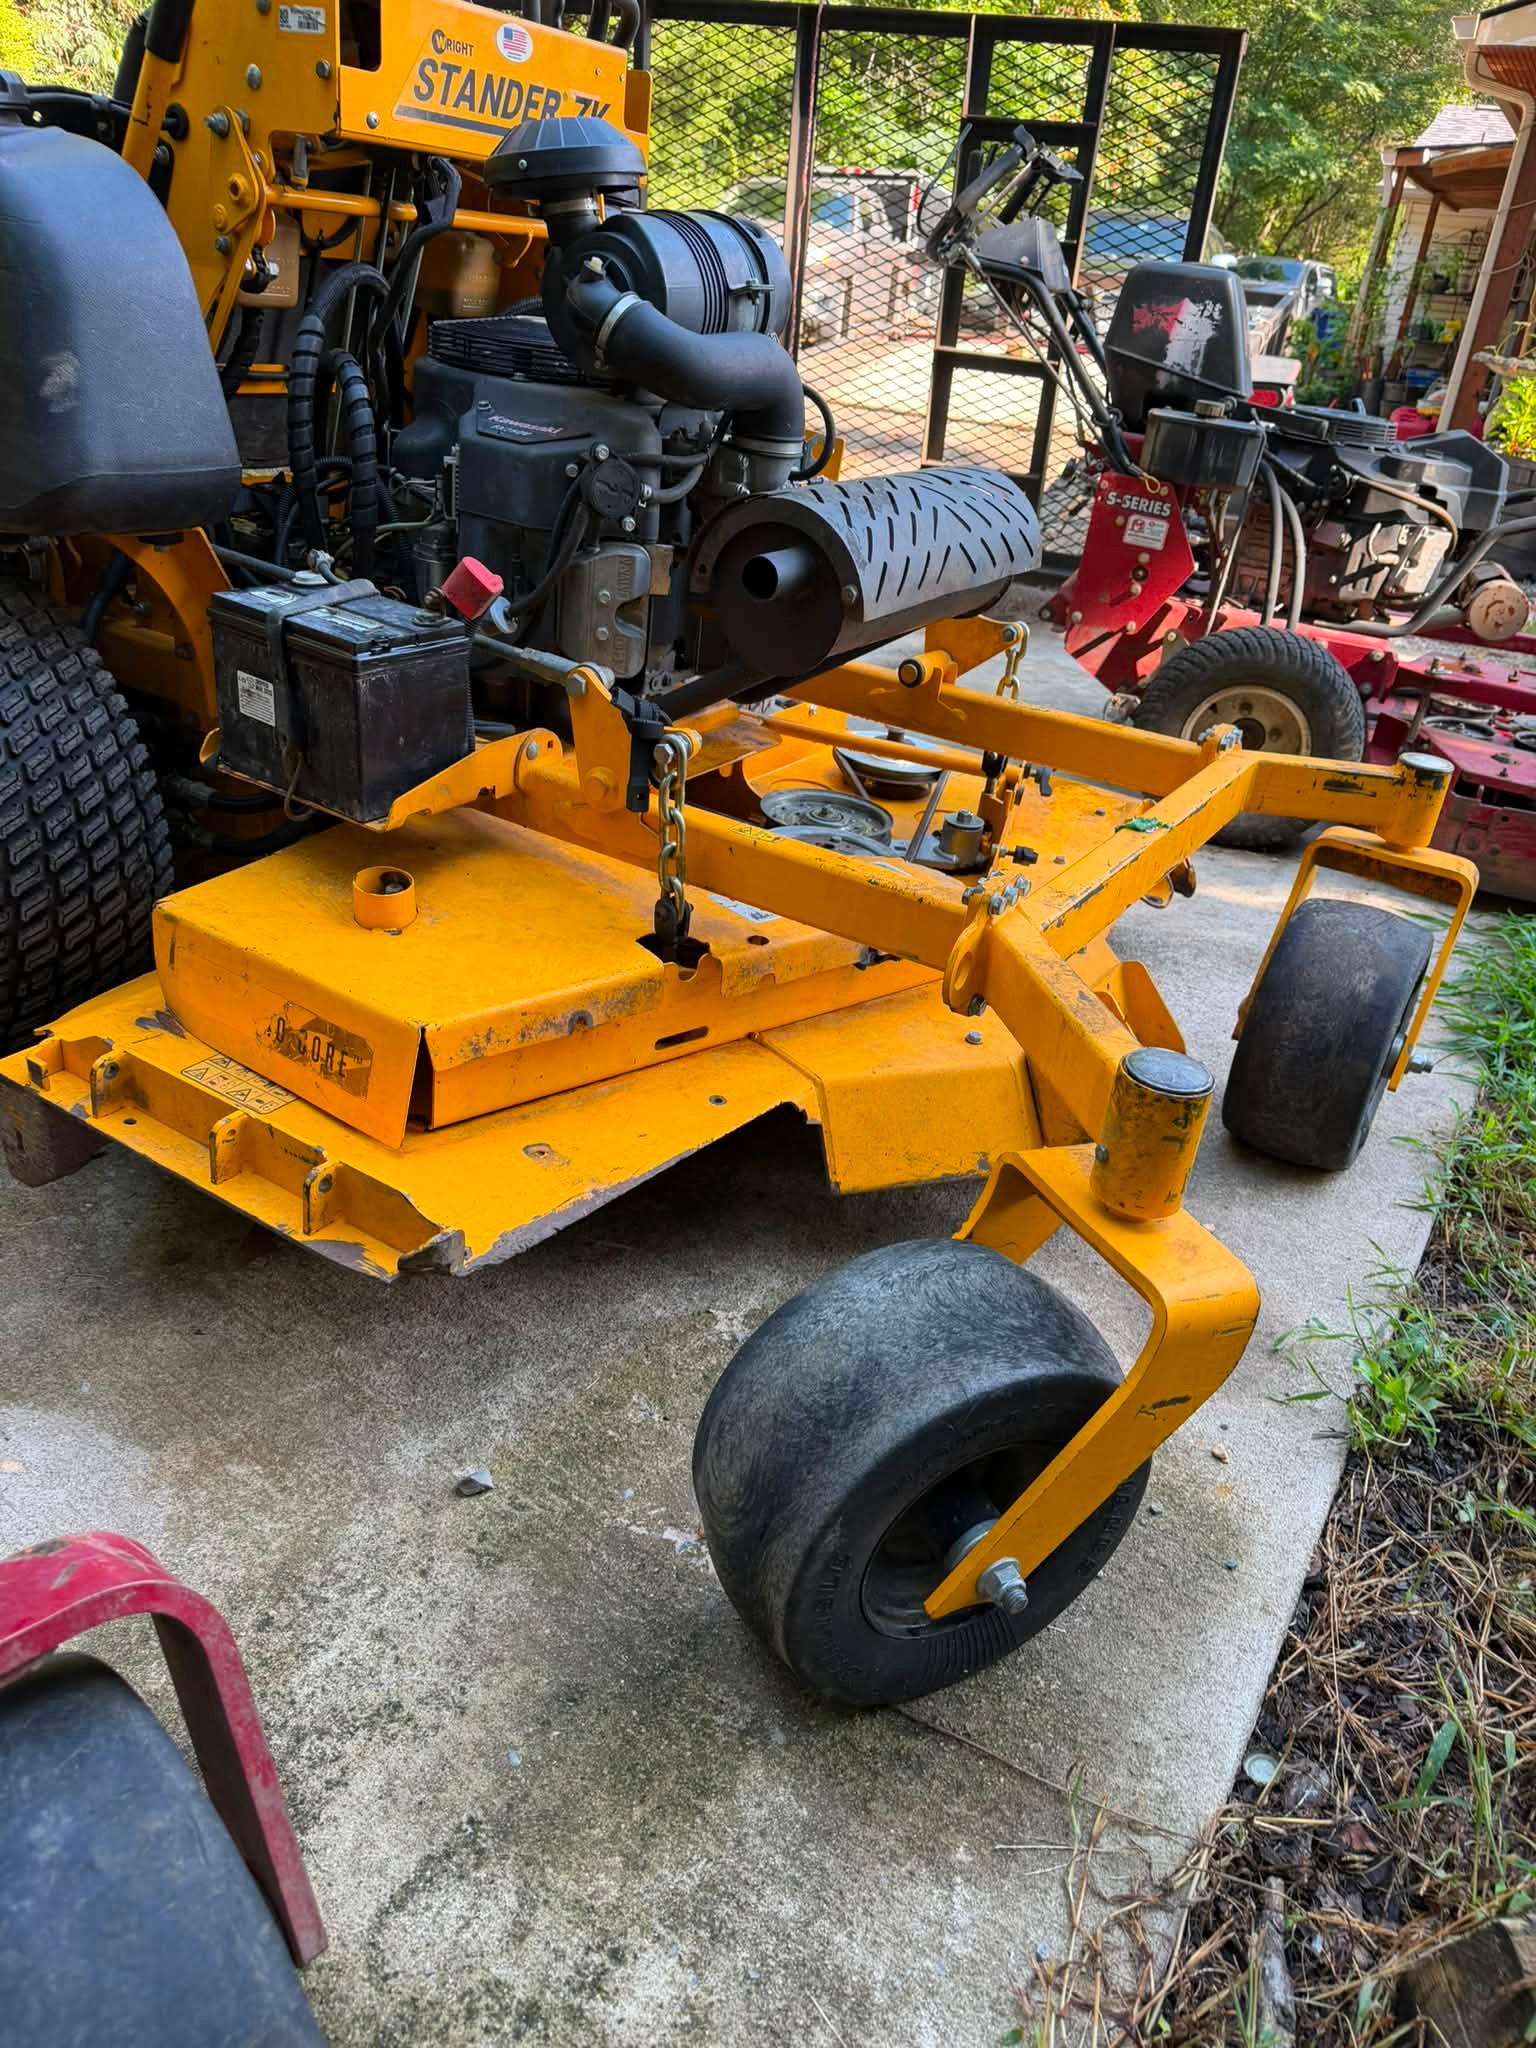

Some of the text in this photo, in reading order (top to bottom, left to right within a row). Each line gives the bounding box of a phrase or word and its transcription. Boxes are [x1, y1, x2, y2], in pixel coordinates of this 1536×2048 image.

[431, 28, 474, 57] WRIGHT
[413, 58, 563, 121] STANDER
[1106, 491, 1171, 517] S-SERIES
